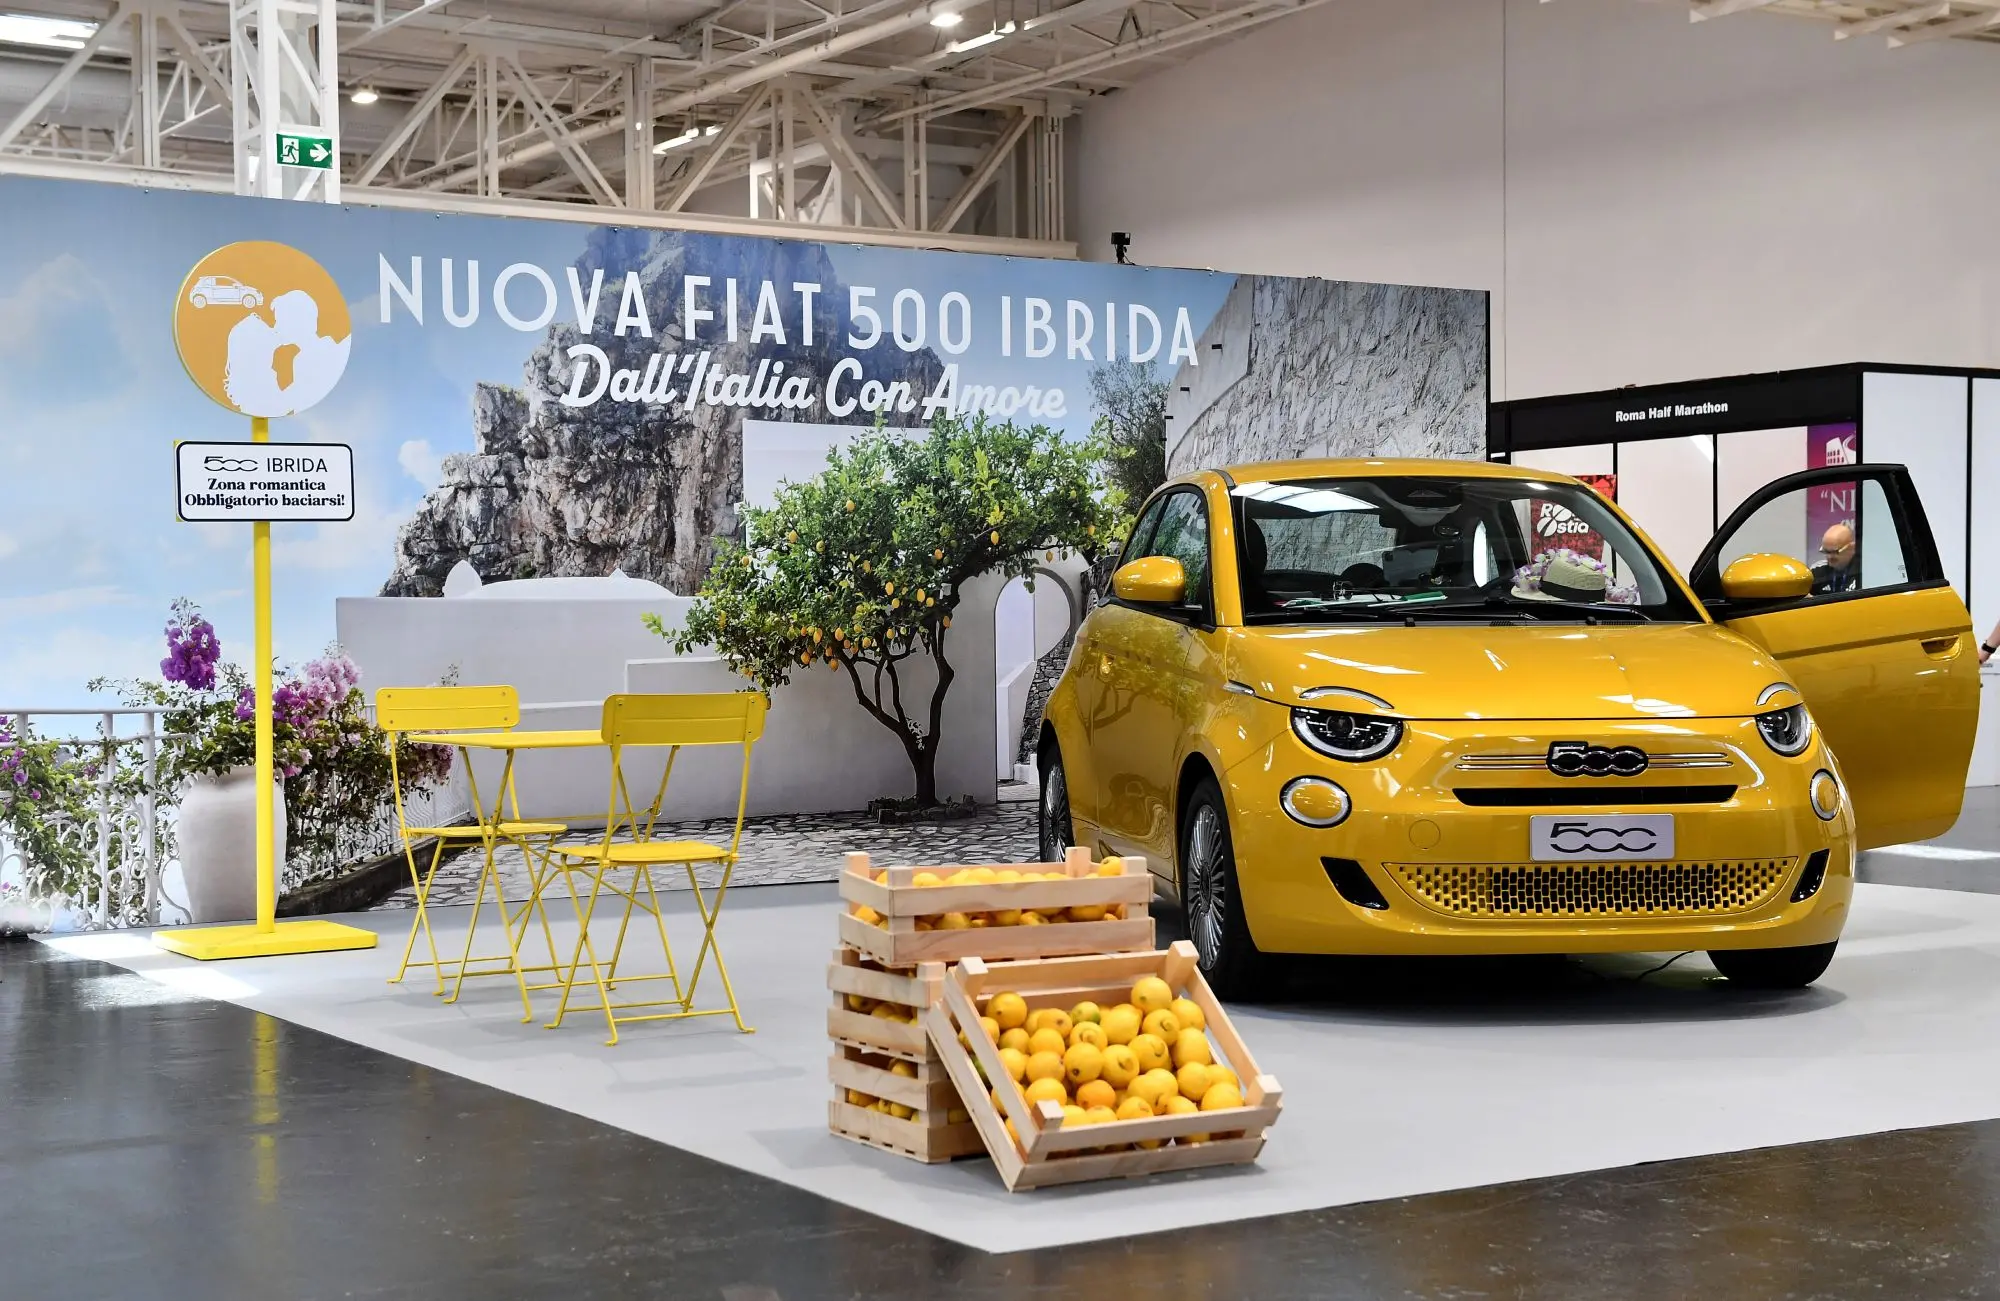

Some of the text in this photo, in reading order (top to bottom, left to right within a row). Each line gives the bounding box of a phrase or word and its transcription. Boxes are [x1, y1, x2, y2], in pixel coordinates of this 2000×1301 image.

[379, 252, 1199, 366] NUOVA FIAT 500 IBRIDA
[560, 343, 1067, 420] Dall'Italia Con Amore
[1615, 402, 1729, 422] Roma Half Marathon
[204, 456, 328, 473] 500 IBRIDA
[207, 478, 326, 491] Zona romantica
[184, 493, 345, 509] Obbligatorio baciarsi!
[1550, 745, 1646, 774] 500
[1550, 822, 1657, 854] 500
